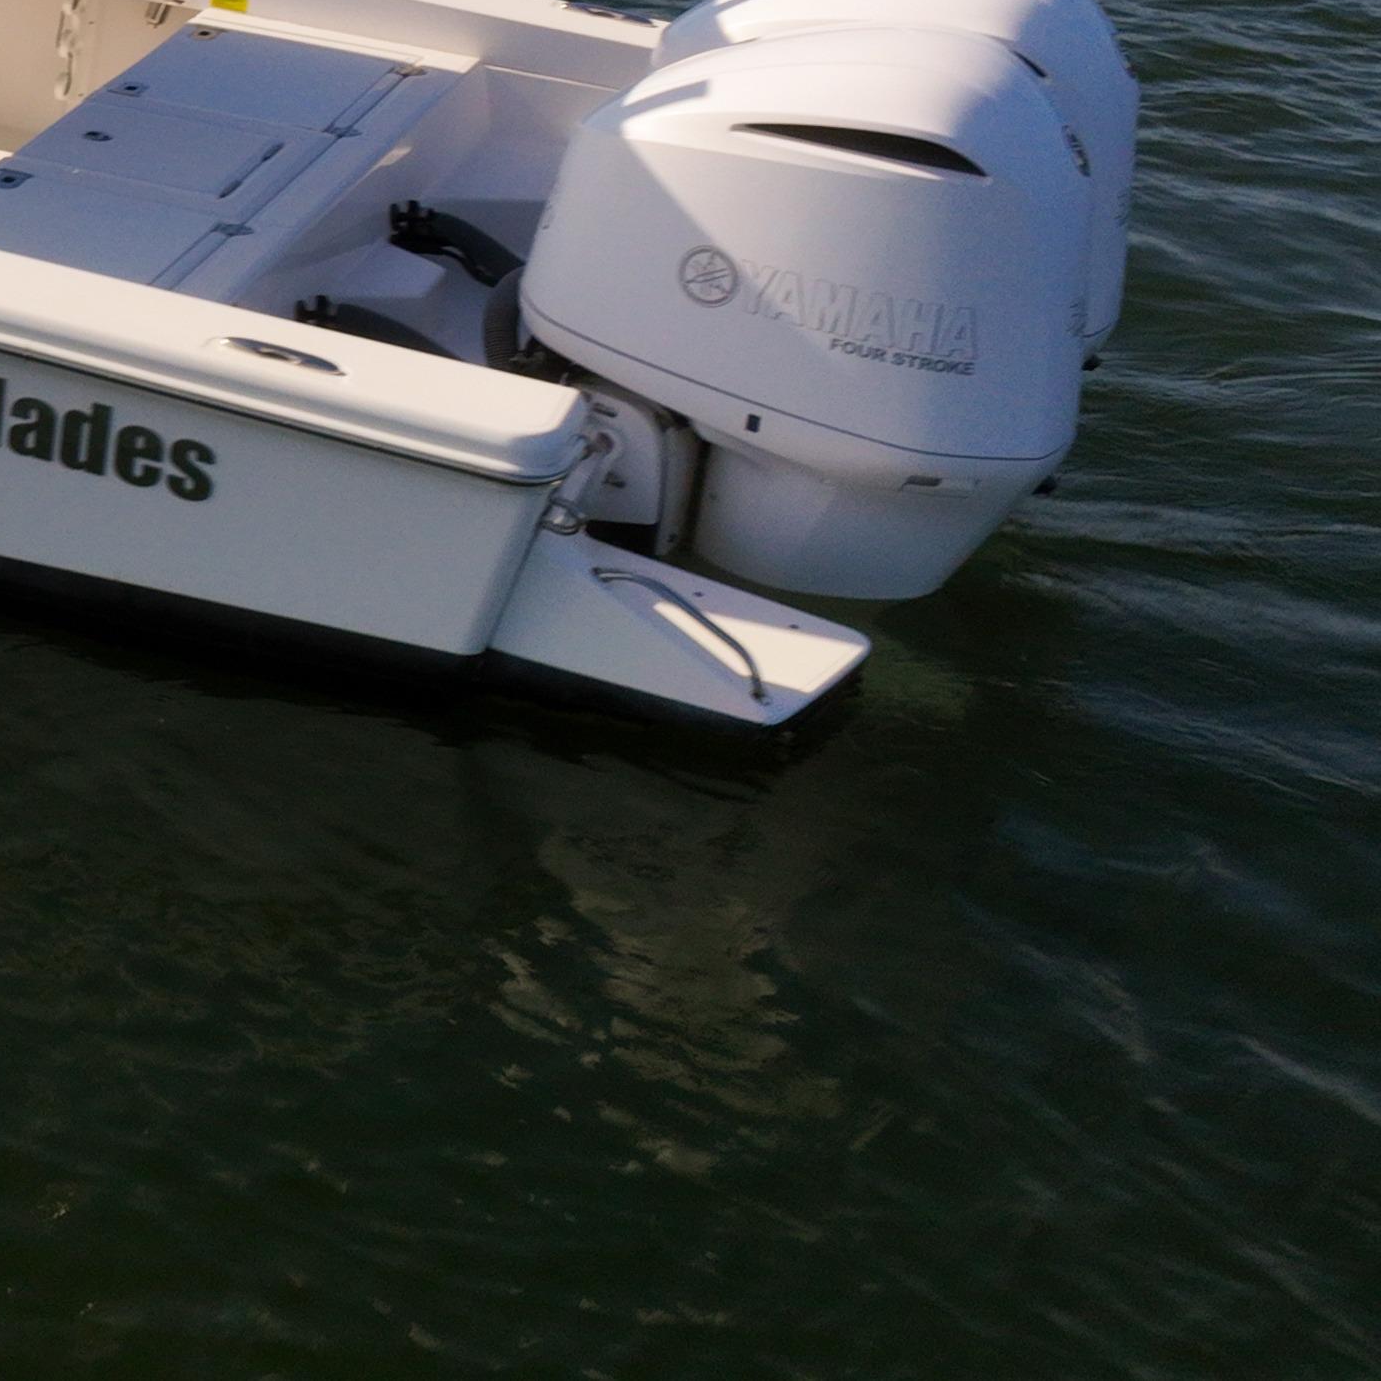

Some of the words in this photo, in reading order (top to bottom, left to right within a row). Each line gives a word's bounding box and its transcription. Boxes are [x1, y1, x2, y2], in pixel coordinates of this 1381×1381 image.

[740, 258, 979, 360] YAMAHA
[829, 337, 888, 364] FOUR
[889, 351, 976, 376] STROKE
